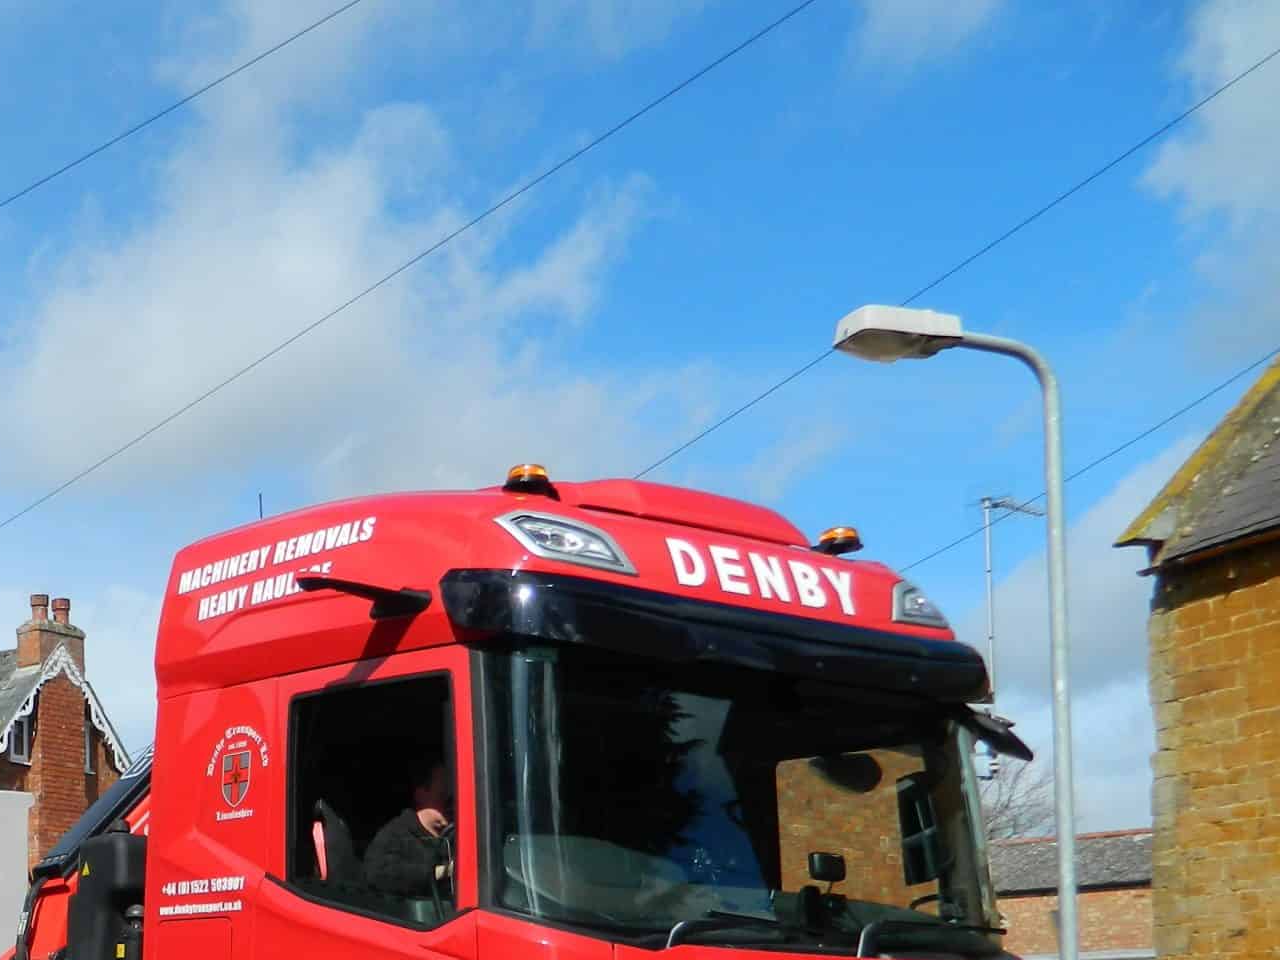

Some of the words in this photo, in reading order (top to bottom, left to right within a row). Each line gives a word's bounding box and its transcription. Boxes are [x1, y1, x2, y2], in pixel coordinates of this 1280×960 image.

[178, 544, 271, 595] MACHINERY
[272, 516, 376, 564] REMOVALS
[665, 536, 856, 616] DENBY
[198, 585, 248, 621] HEAVY
